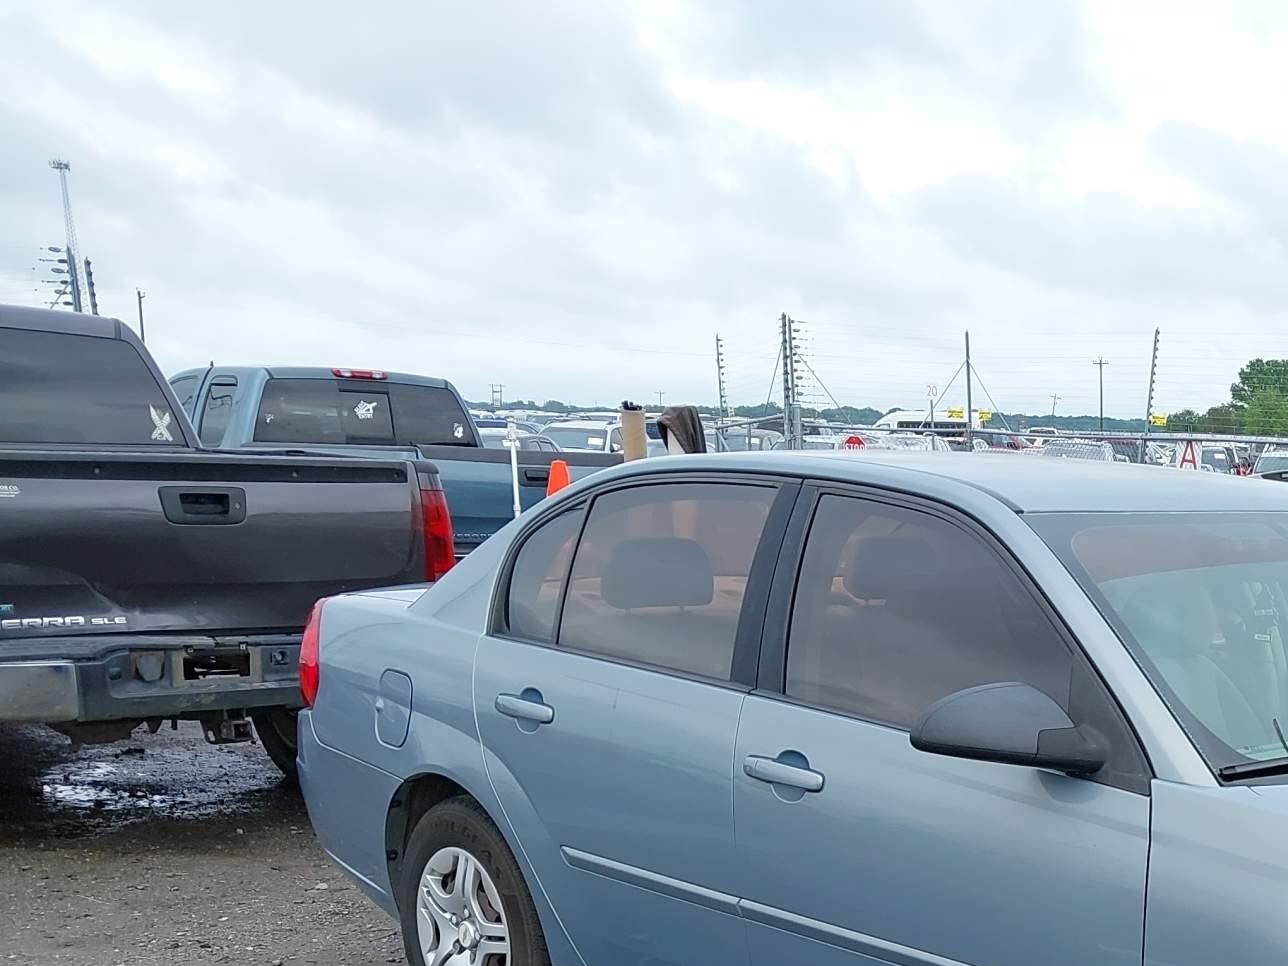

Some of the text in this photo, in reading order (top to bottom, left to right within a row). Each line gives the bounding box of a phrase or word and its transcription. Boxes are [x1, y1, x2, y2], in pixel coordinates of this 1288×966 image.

[927, 384, 938, 397] 20
[1179, 440, 1198, 470] A
[0, 616, 128, 630] ERRA SLE
